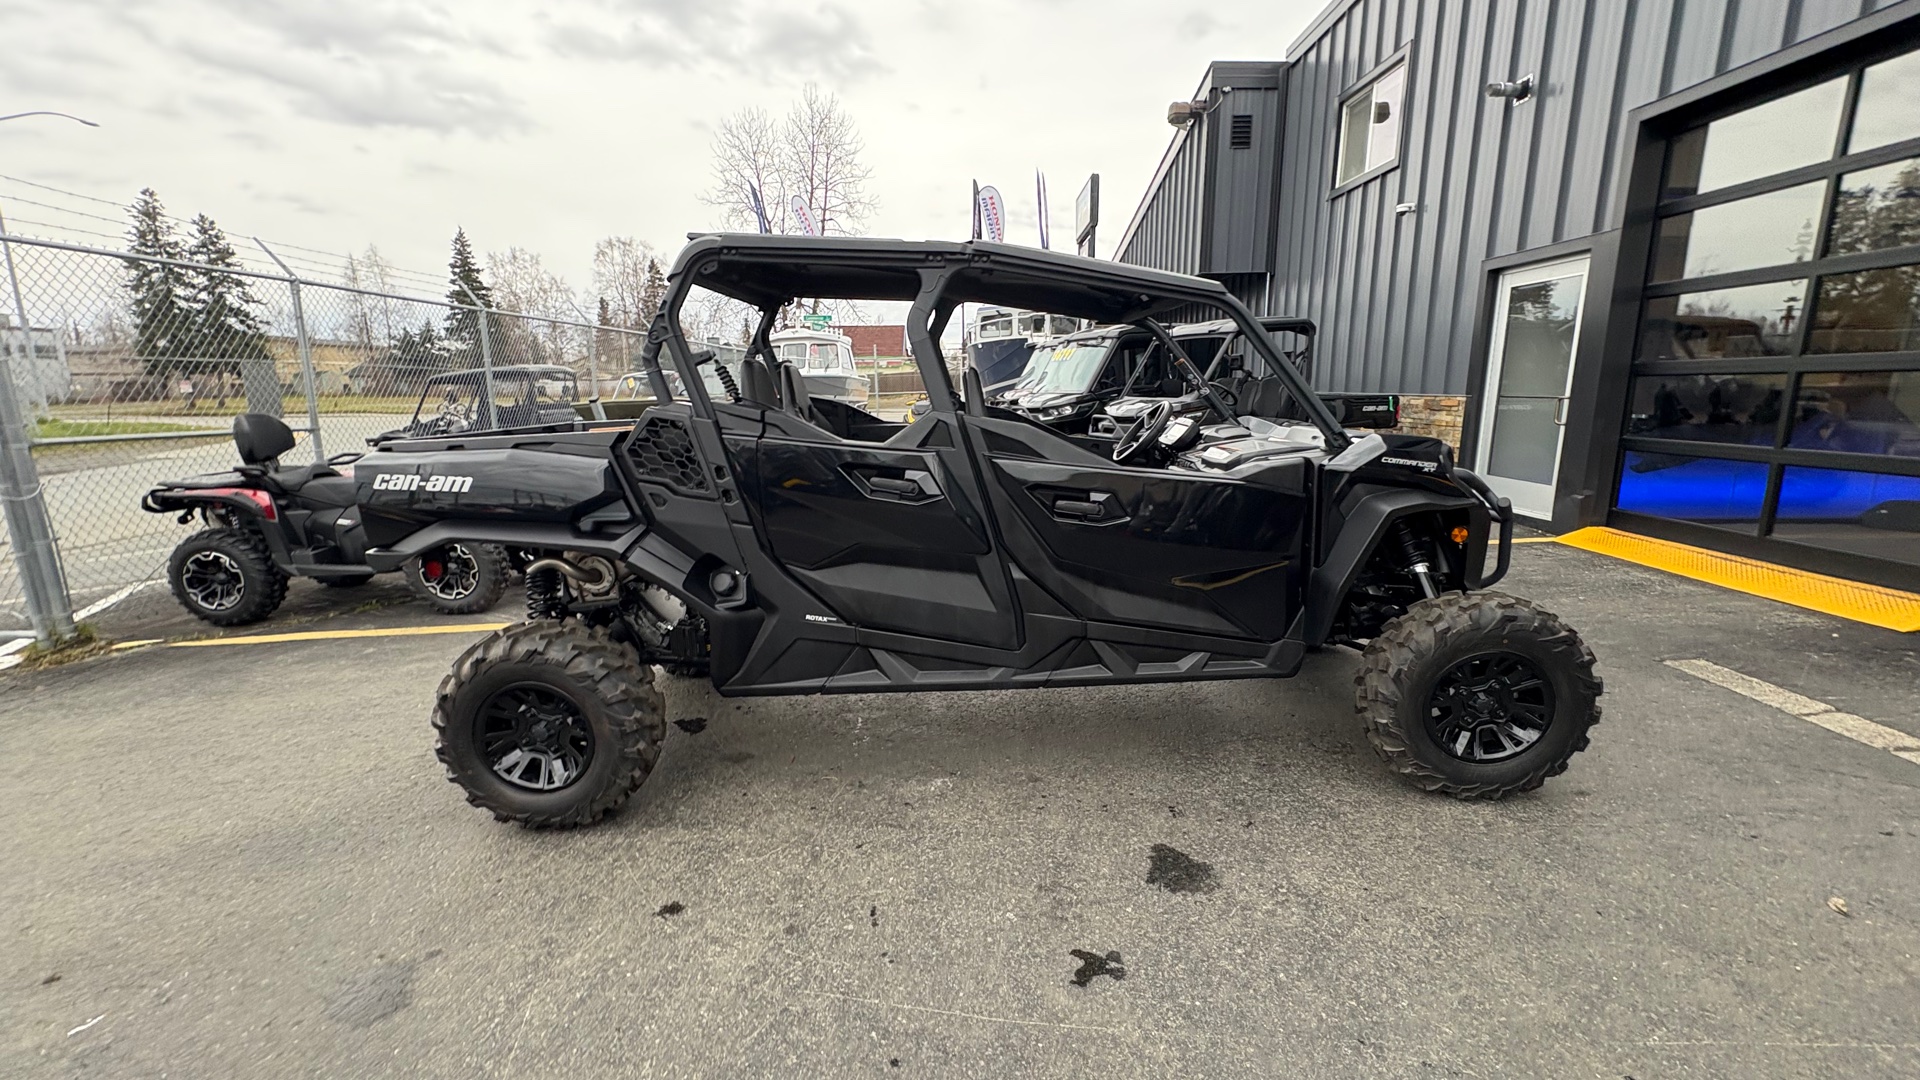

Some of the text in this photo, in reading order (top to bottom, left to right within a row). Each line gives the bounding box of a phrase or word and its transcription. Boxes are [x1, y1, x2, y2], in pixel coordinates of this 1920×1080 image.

[1381, 456, 1438, 469] COMMANDER
[372, 473, 474, 493] can-am
[805, 614, 828, 622] ROTAX
